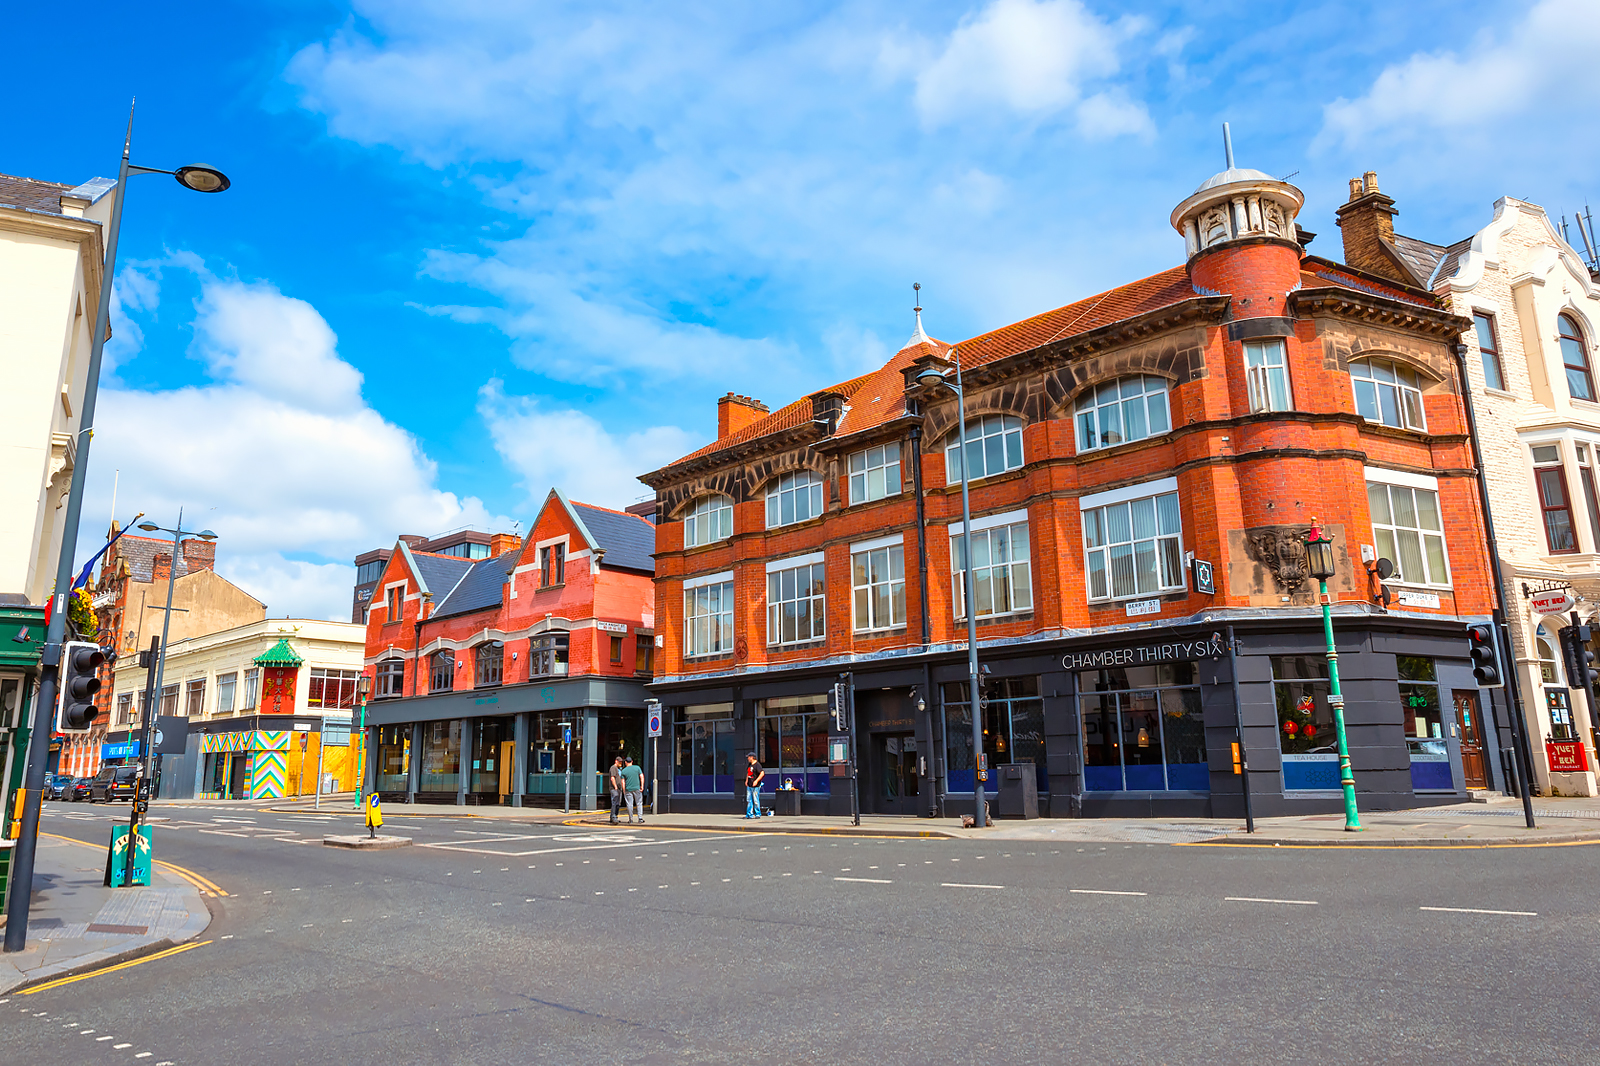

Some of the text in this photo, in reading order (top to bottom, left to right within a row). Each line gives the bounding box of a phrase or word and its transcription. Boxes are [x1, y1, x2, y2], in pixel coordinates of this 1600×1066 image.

[1531, 595, 1566, 609] YUET BEN
[1062, 648, 1134, 670] CHAMBER
[868, 719, 891, 728] CHAMBER
[1553, 745, 1575, 756] YUET
[1558, 755, 1575, 764] BEN
[115, 867, 146, 879] SPITZ
